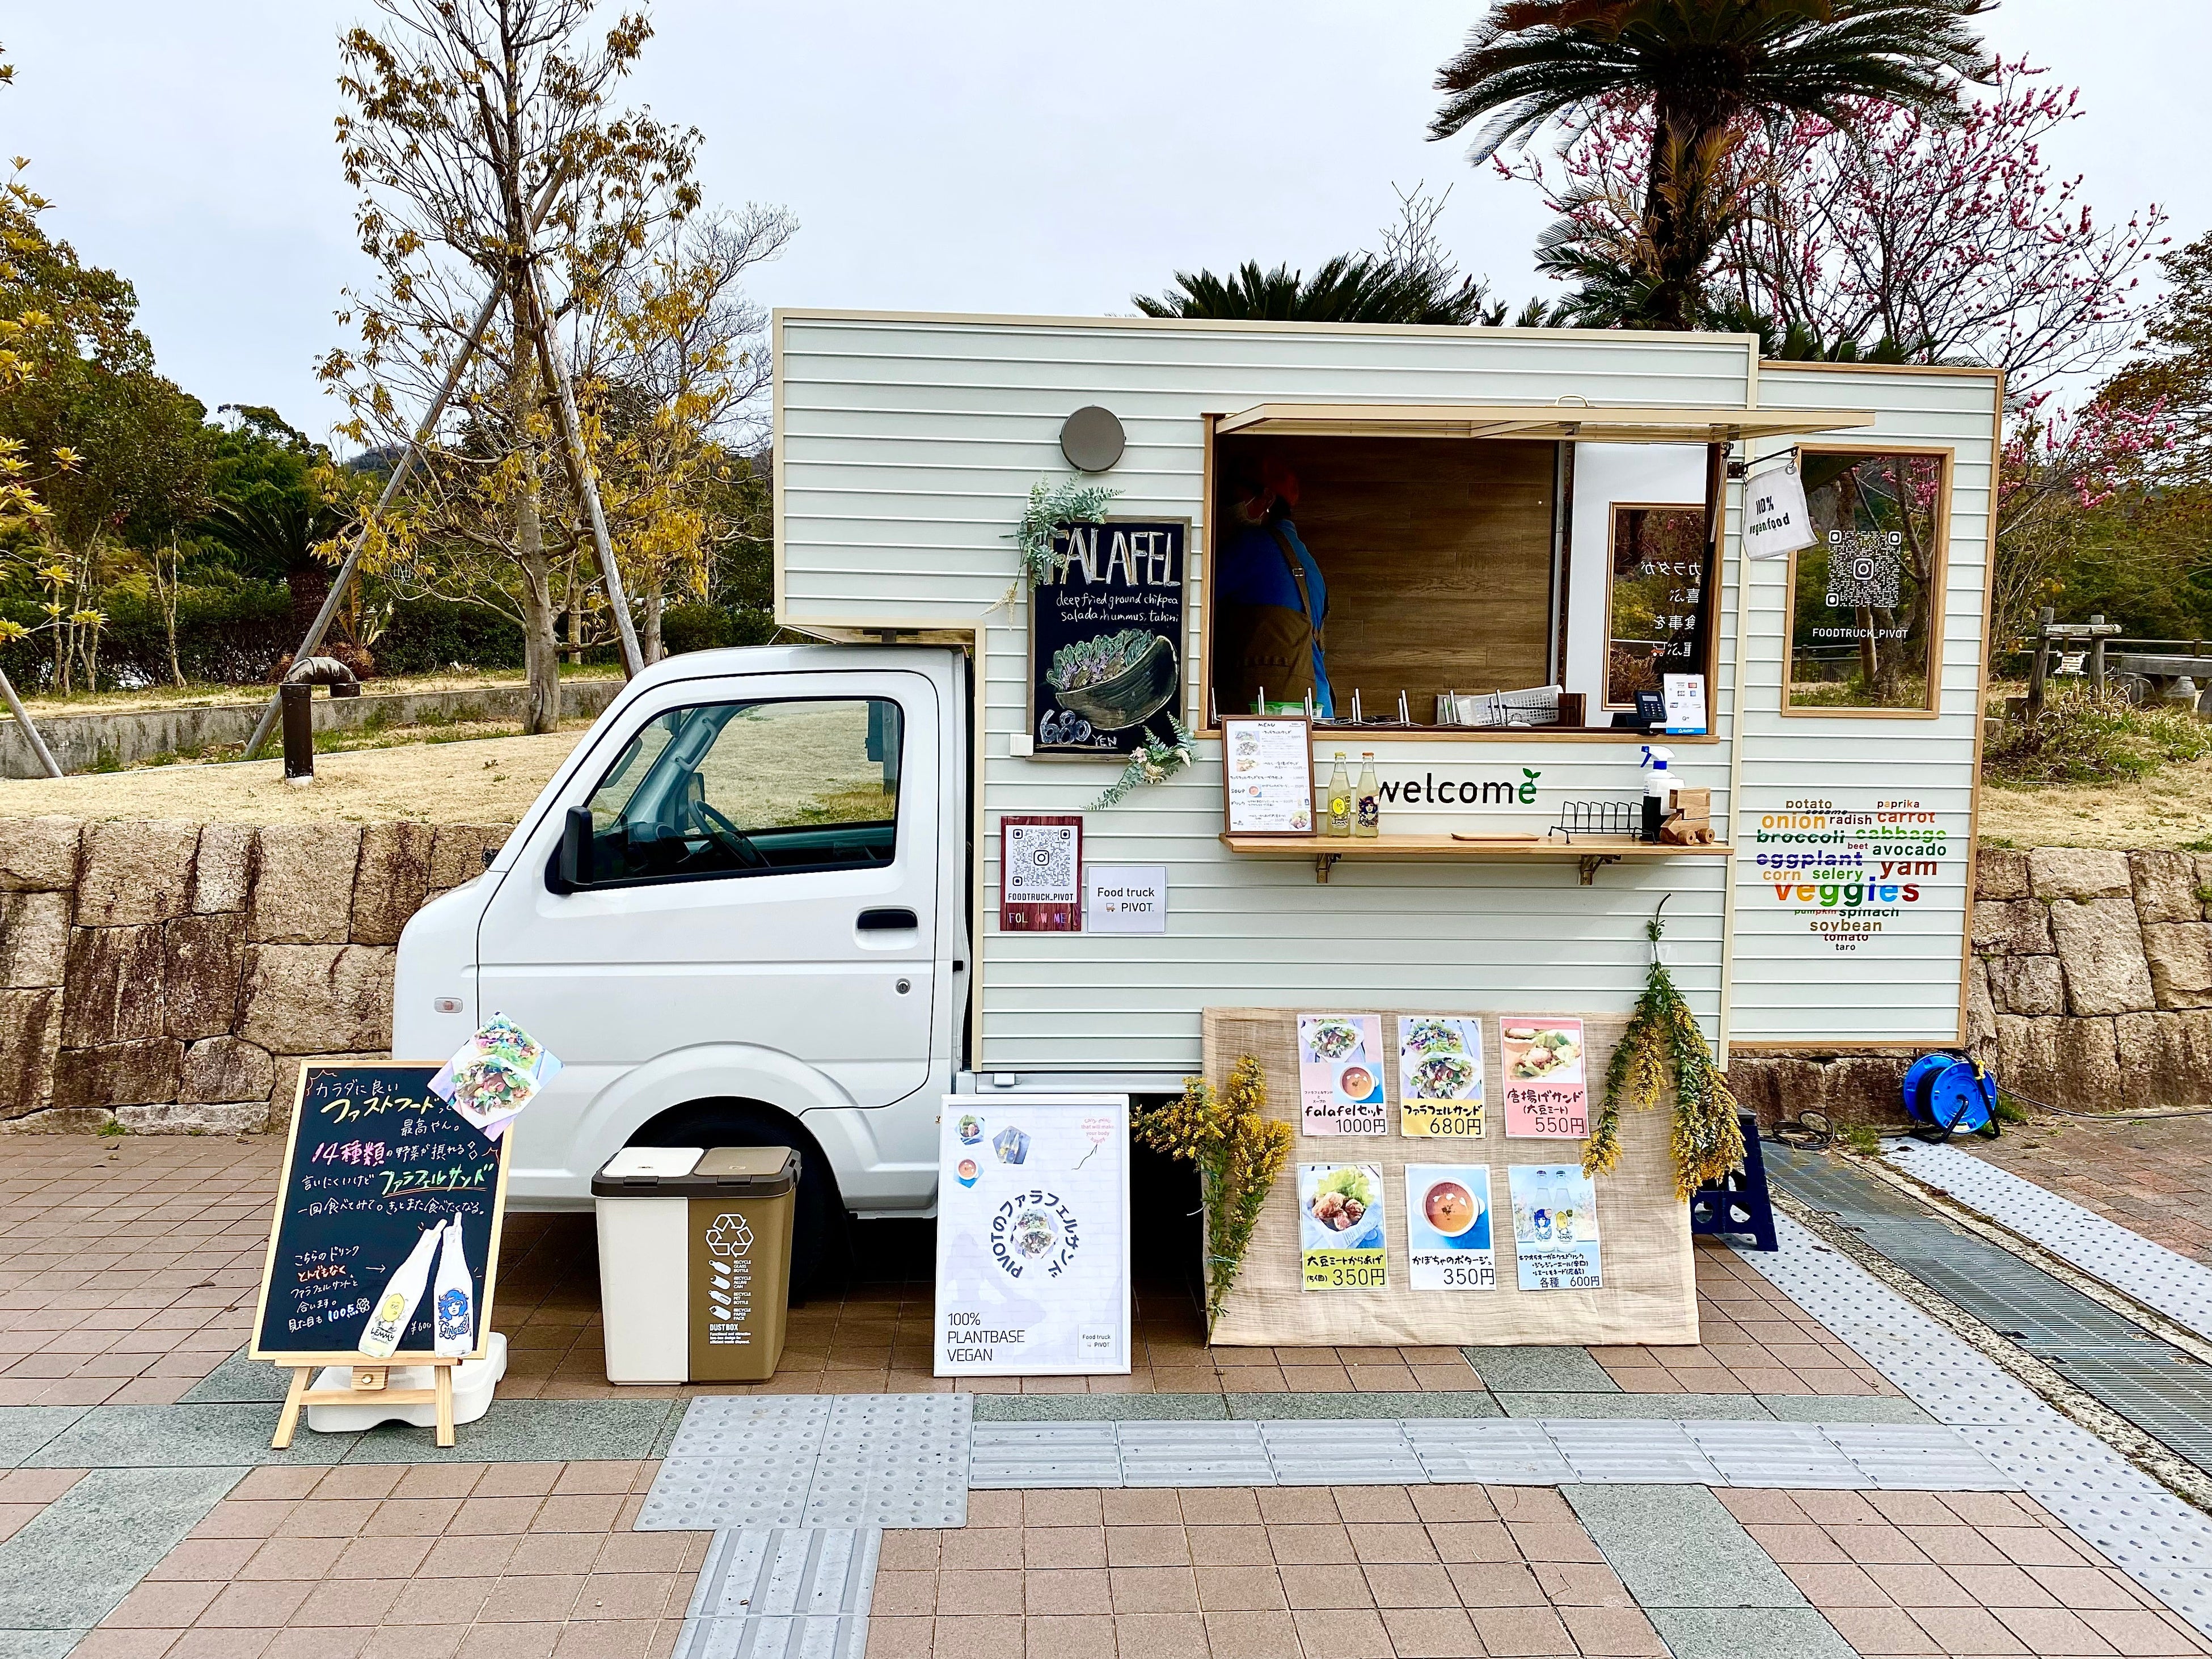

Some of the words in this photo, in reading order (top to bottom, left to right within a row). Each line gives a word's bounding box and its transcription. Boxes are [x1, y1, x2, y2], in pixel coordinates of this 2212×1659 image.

[1043, 527, 1181, 587] FALAFEL
[1056, 590, 1079, 607] deep
[1081, 592, 1107, 607] fried
[1109, 593, 1142, 610] ground
[1148, 609, 1179, 622] tahini
[1812, 628, 1908, 639] FOODTRUCK_PIVOT
[1040, 709, 1091, 744] 680
[1092, 734, 1117, 748] YEN
[1379, 772, 1536, 804] welcome
[1786, 799, 1833, 809] potato
[1877, 800, 1920, 809] paprika
[1762, 812, 1826, 829] onion
[1830, 814, 1872, 825] radish
[1877, 812, 1935, 824] carrot
[1756, 829, 1844, 843] broccoli
[1855, 826, 1947, 843] cabbage
[1872, 843, 1947, 856] avocado
[1756, 850, 1863, 869] eggplant
[1763, 869, 1801, 880] corn
[1812, 867, 1864, 882] selery
[1880, 860, 1937, 879] yam
[1097, 887, 1123, 897] Food
[1126, 887, 1155, 897] truck
[1774, 876, 1920, 907] veggies
[1008, 911, 1048, 923] FOLOW
[1839, 907, 1899, 918] spinach
[1810, 919, 1882, 932] soybean
[316, 1079, 398, 1097] カラダに良い
[1507, 1088, 1584, 1104] 唐揚げサンド
[1305, 1104, 1383, 1117] falafelセット
[1403, 1104, 1483, 1116] ファラフェルサンド
[1523, 1105, 1568, 1115] (大豆ミート)
[400, 1118, 459, 1137] 最高やん。
[1335, 1119, 1386, 1133] 1000円
[1430, 1117, 1481, 1135] 680円
[1535, 1117, 1585, 1134] 550円
[312, 1139, 465, 1167] 14種類の野菜が摂れる
[294, 1245, 360, 1266] こちらのドリンク
[1307, 1254, 1384, 1267] 大豆ミートからあげ
[1412, 1255, 1493, 1265] かぼちゃのポタージュ
[298, 1265, 347, 1283] とんでもなく
[1333, 1268, 1385, 1286] 350円
[1443, 1269, 1494, 1285] 350円
[1540, 1277, 1560, 1288] 各種
[1570, 1276, 1600, 1287] 600円
[296, 1299, 337, 1313] 合います。
[948, 1312, 981, 1325] 100%
[370, 1327, 395, 1341] LEMMY
[410, 1320, 432, 1335] ¥600
[948, 1330, 1025, 1344] PLANTBASE
[947, 1349, 993, 1362] VEGAN
